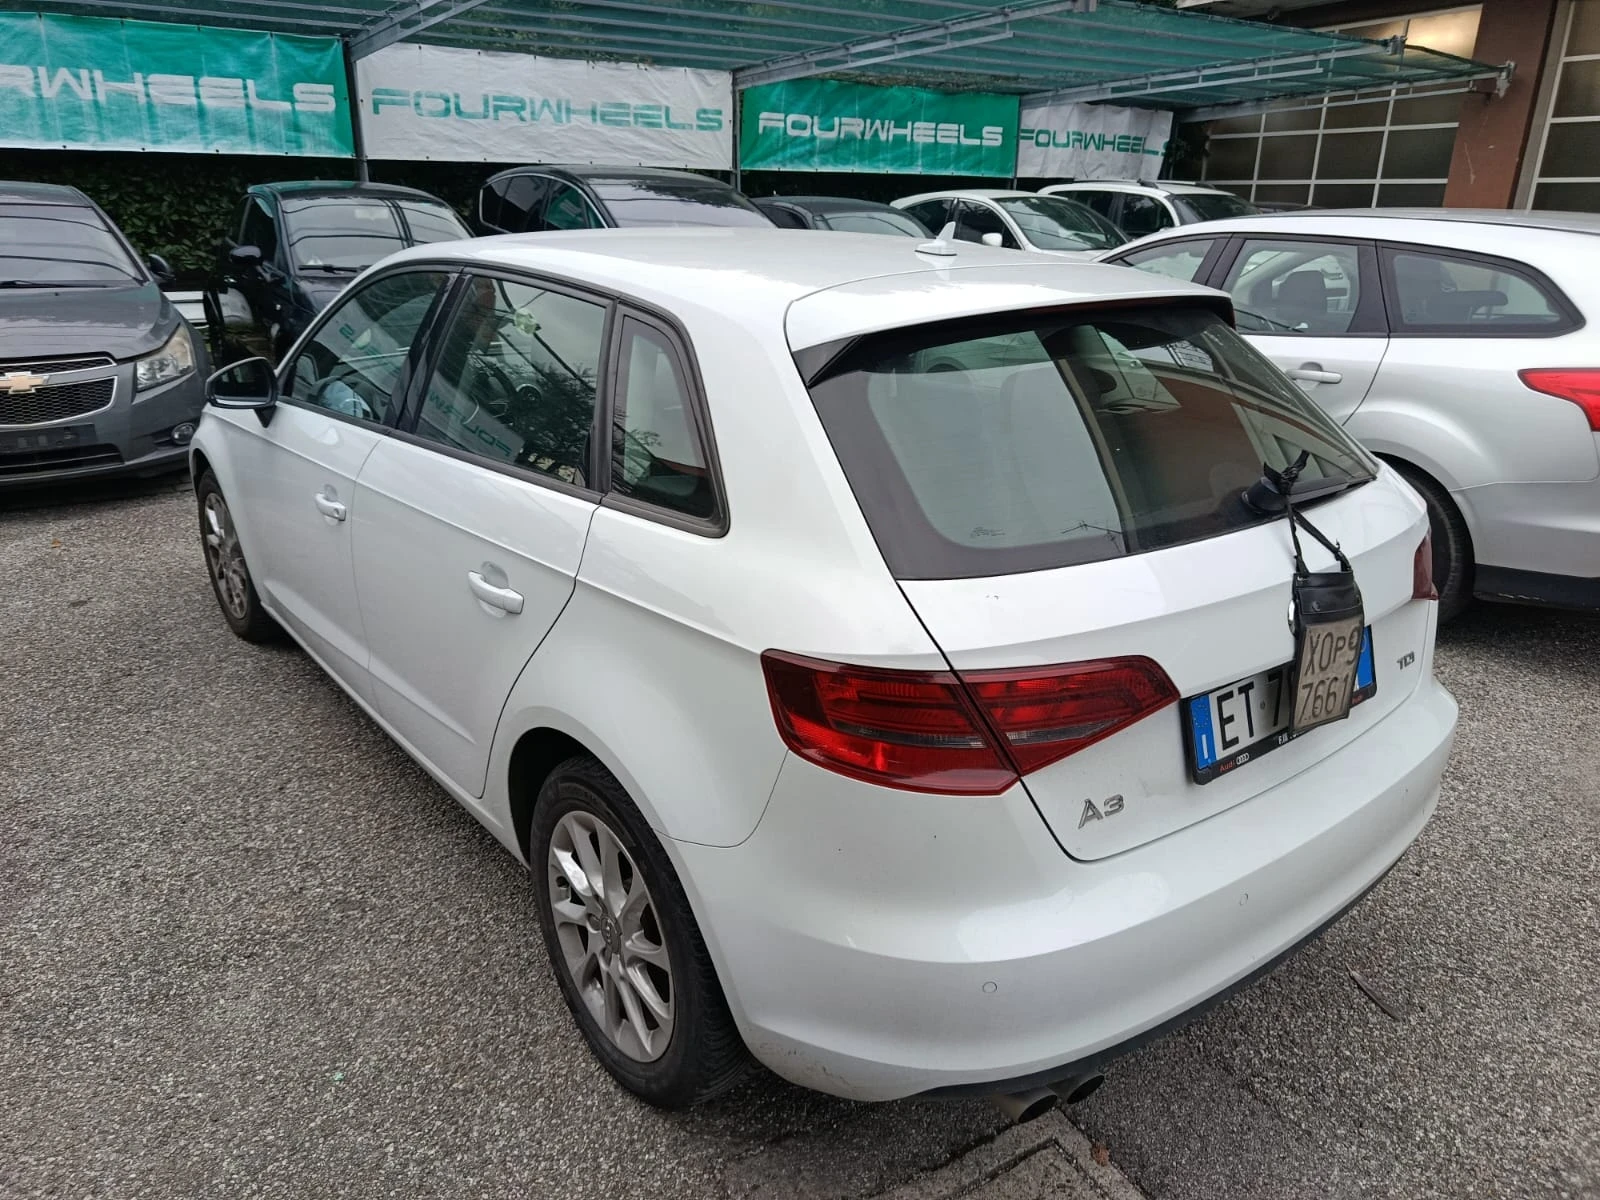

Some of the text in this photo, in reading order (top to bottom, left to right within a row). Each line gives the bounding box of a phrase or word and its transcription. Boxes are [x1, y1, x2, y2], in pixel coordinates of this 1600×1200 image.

[371, 87, 724, 132] FOURWHEELS
[758, 111, 1004, 147] FOURWHEELS
[1216, 680, 1255, 751] ET
[1298, 673, 1350, 724] 7661
[1077, 793, 1125, 830] A3
